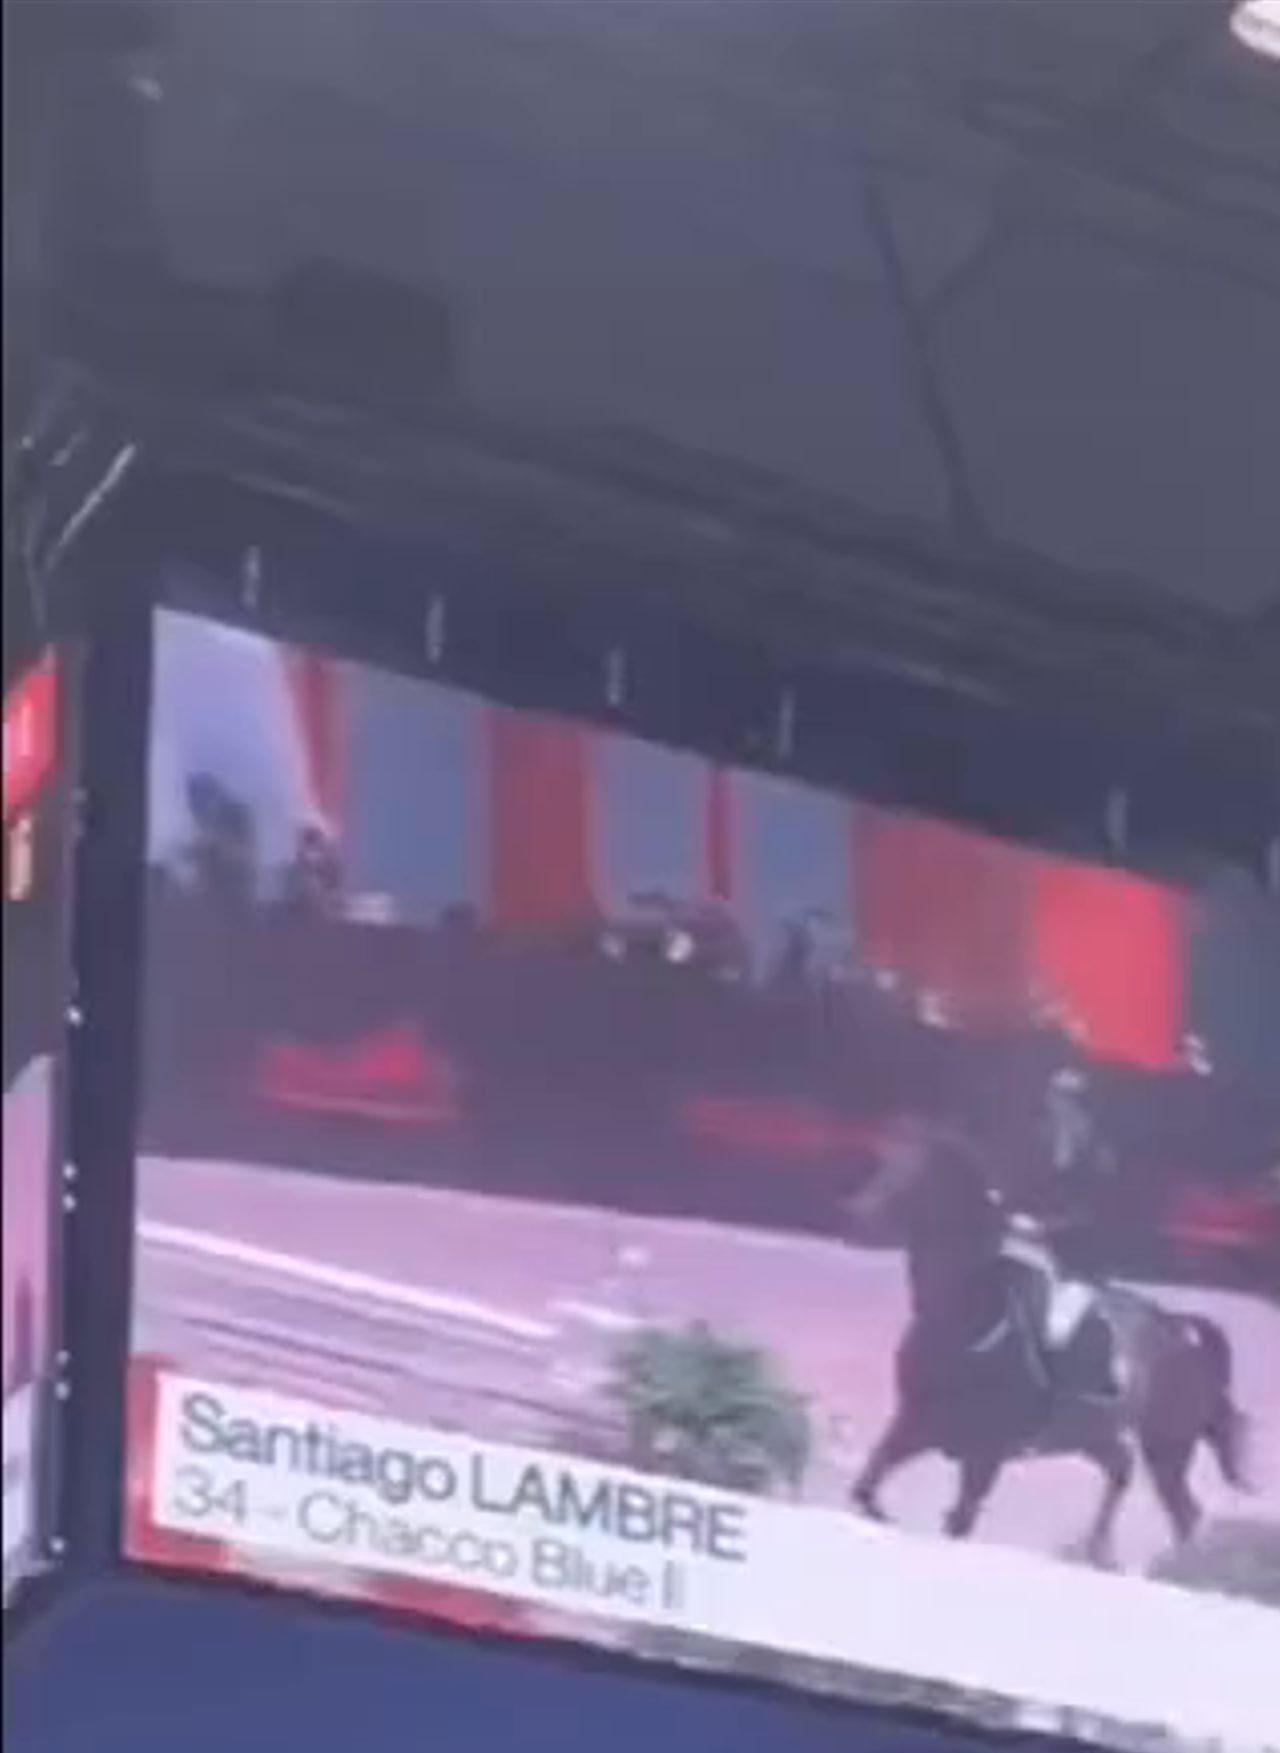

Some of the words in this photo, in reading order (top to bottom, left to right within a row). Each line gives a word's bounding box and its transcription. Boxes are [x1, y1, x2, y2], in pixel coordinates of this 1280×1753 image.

[174, 1464, 248, 1523] 34
[298, 1490, 519, 1578] Chacco
[531, 1537, 652, 1605] Blue
[180, 1393, 457, 1502] Santiago
[472, 1453, 748, 1562] LAMBRE
